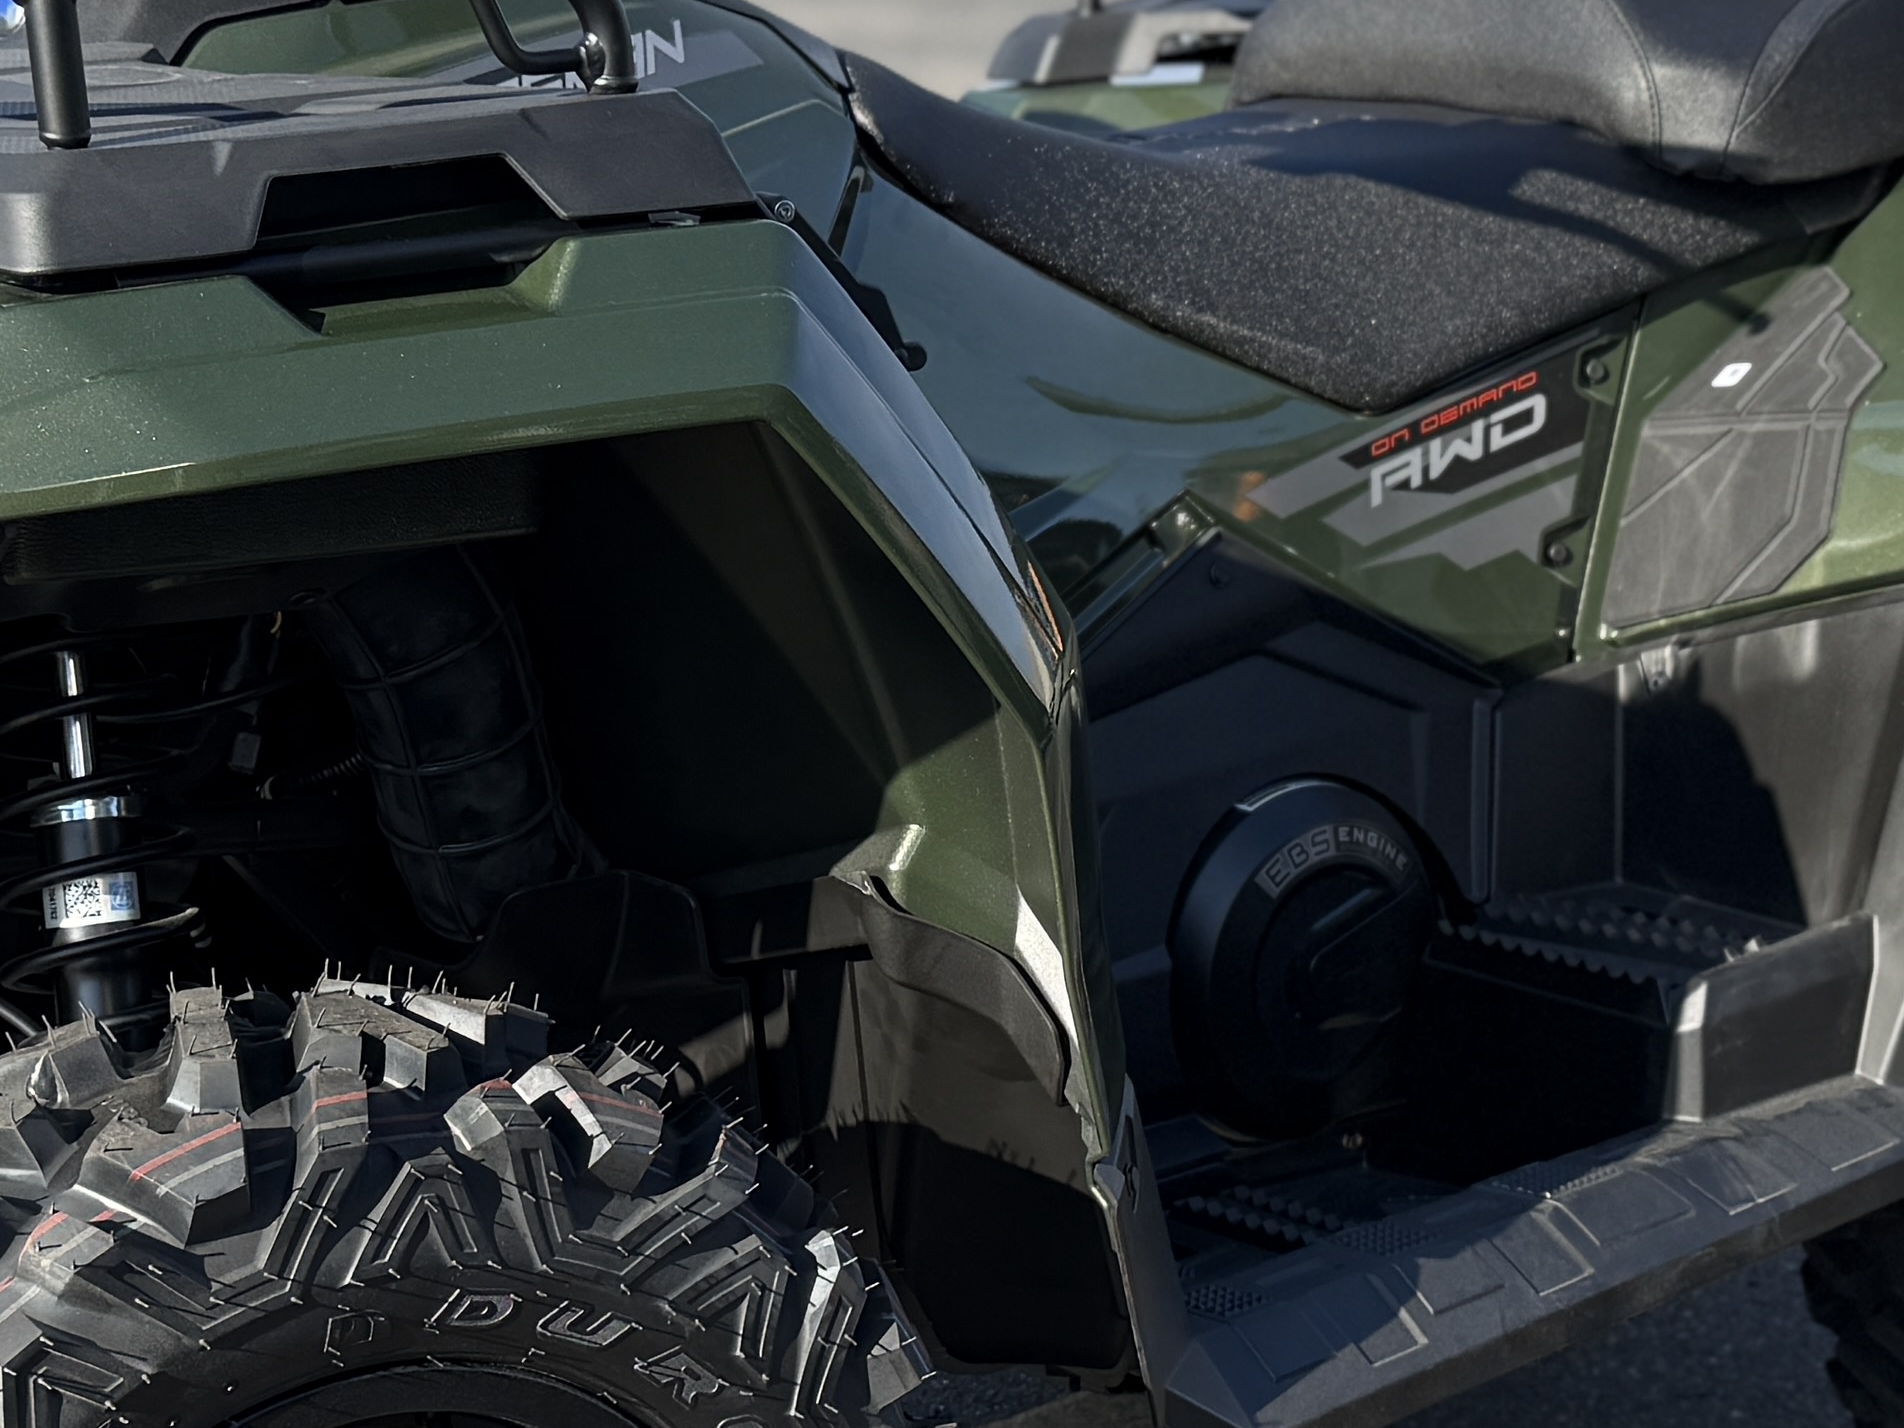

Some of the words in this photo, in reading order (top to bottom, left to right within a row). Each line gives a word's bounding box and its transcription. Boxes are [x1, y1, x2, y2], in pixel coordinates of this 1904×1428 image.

[1370, 428, 1410, 458] ON
[1419, 371, 1538, 435] DEMAND
[1370, 392, 1547, 509] AWD
[1263, 828, 1332, 891] EBS
[1337, 826, 1409, 871] ENGINE
